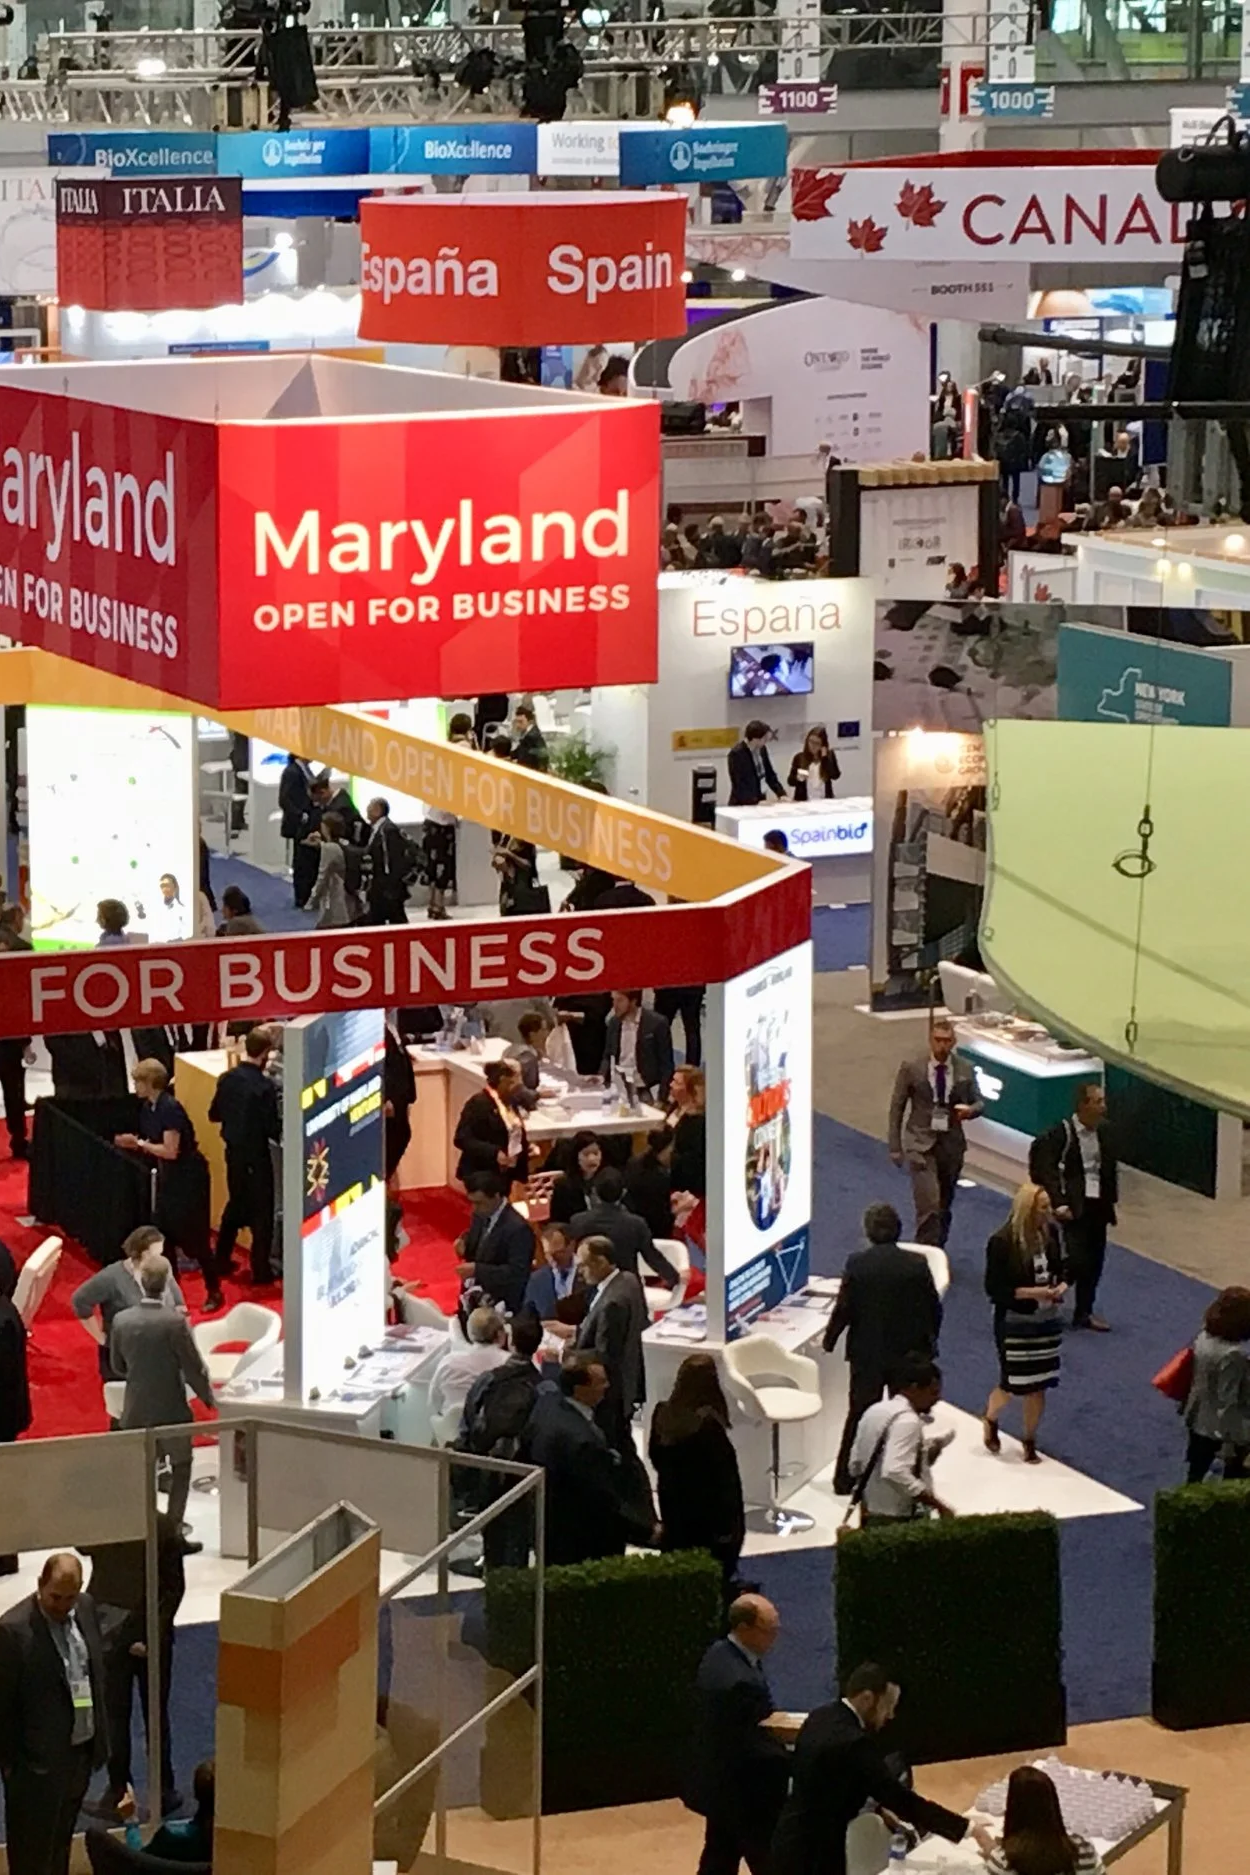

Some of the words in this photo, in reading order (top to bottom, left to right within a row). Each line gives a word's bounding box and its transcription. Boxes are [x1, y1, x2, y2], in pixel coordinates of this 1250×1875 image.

[779, 91, 818, 108] 1100
[990, 91, 1035, 110] 1000
[424, 139, 513, 161] BioXcellence
[552, 132, 605, 152] Working
[95, 147, 215, 168] BioXcellence
[61, 186, 99, 214] ITALIA
[122, 185, 227, 214] ITALIA
[547, 241, 672, 304] Spain
[931, 283, 972, 295] BOOTH
[253, 489, 630, 586] Maryland
[23, 571, 65, 624] FOR
[69, 588, 178, 660] BUSINESS
[253, 602, 355, 633] OPEN
[368, 595, 440, 625] FOR
[452, 584, 631, 620] BUSINESS
[386, 740, 451, 803] OPEN
[463, 766, 517, 821] FOR
[526, 784, 672, 884] BUSINESS
[790, 822, 868, 845] Spainbio
[31, 957, 186, 1023] FOR
[218, 927, 606, 1010] BUSINESS
